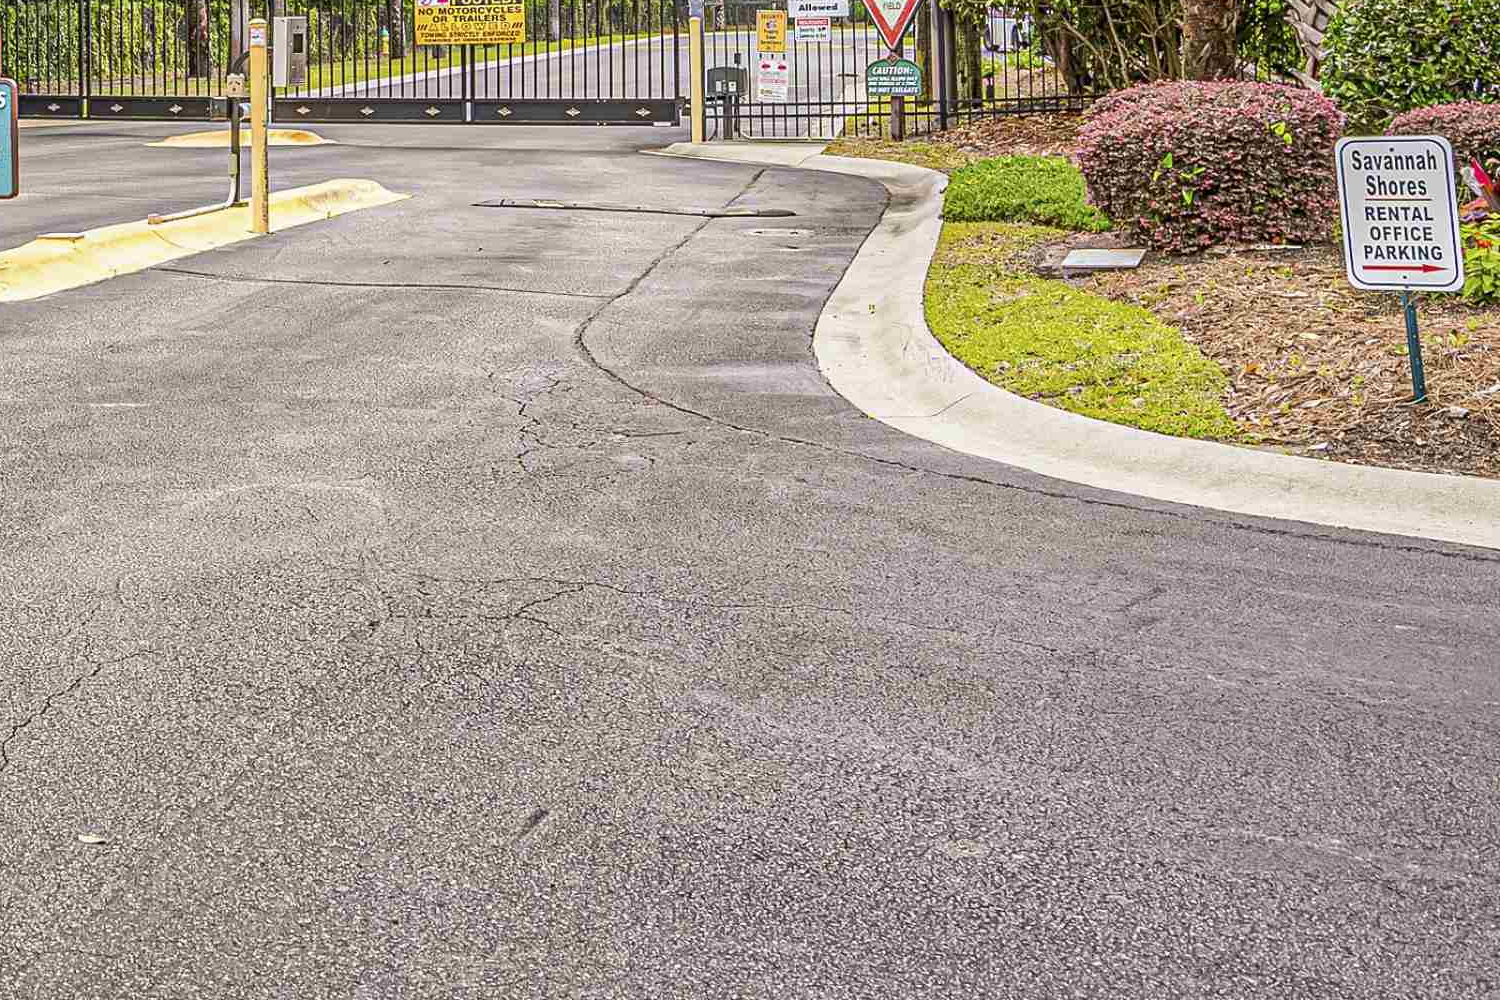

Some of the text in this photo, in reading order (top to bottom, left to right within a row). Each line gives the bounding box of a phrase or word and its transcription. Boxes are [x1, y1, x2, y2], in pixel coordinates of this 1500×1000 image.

[418, 6, 521, 16] NO MOTORCYCLES
[798, 3, 838, 12] Allowed
[432, 14, 507, 23] OR TRAILERS
[872, 66, 913, 75] CAUTION:
[1351, 149, 1437, 170] Savannah
[1366, 175, 1427, 196] Shores
[1365, 206, 1434, 221] RENTAL
[1370, 226, 1433, 241] OFFICE
[1364, 245, 1443, 261] PARKING
